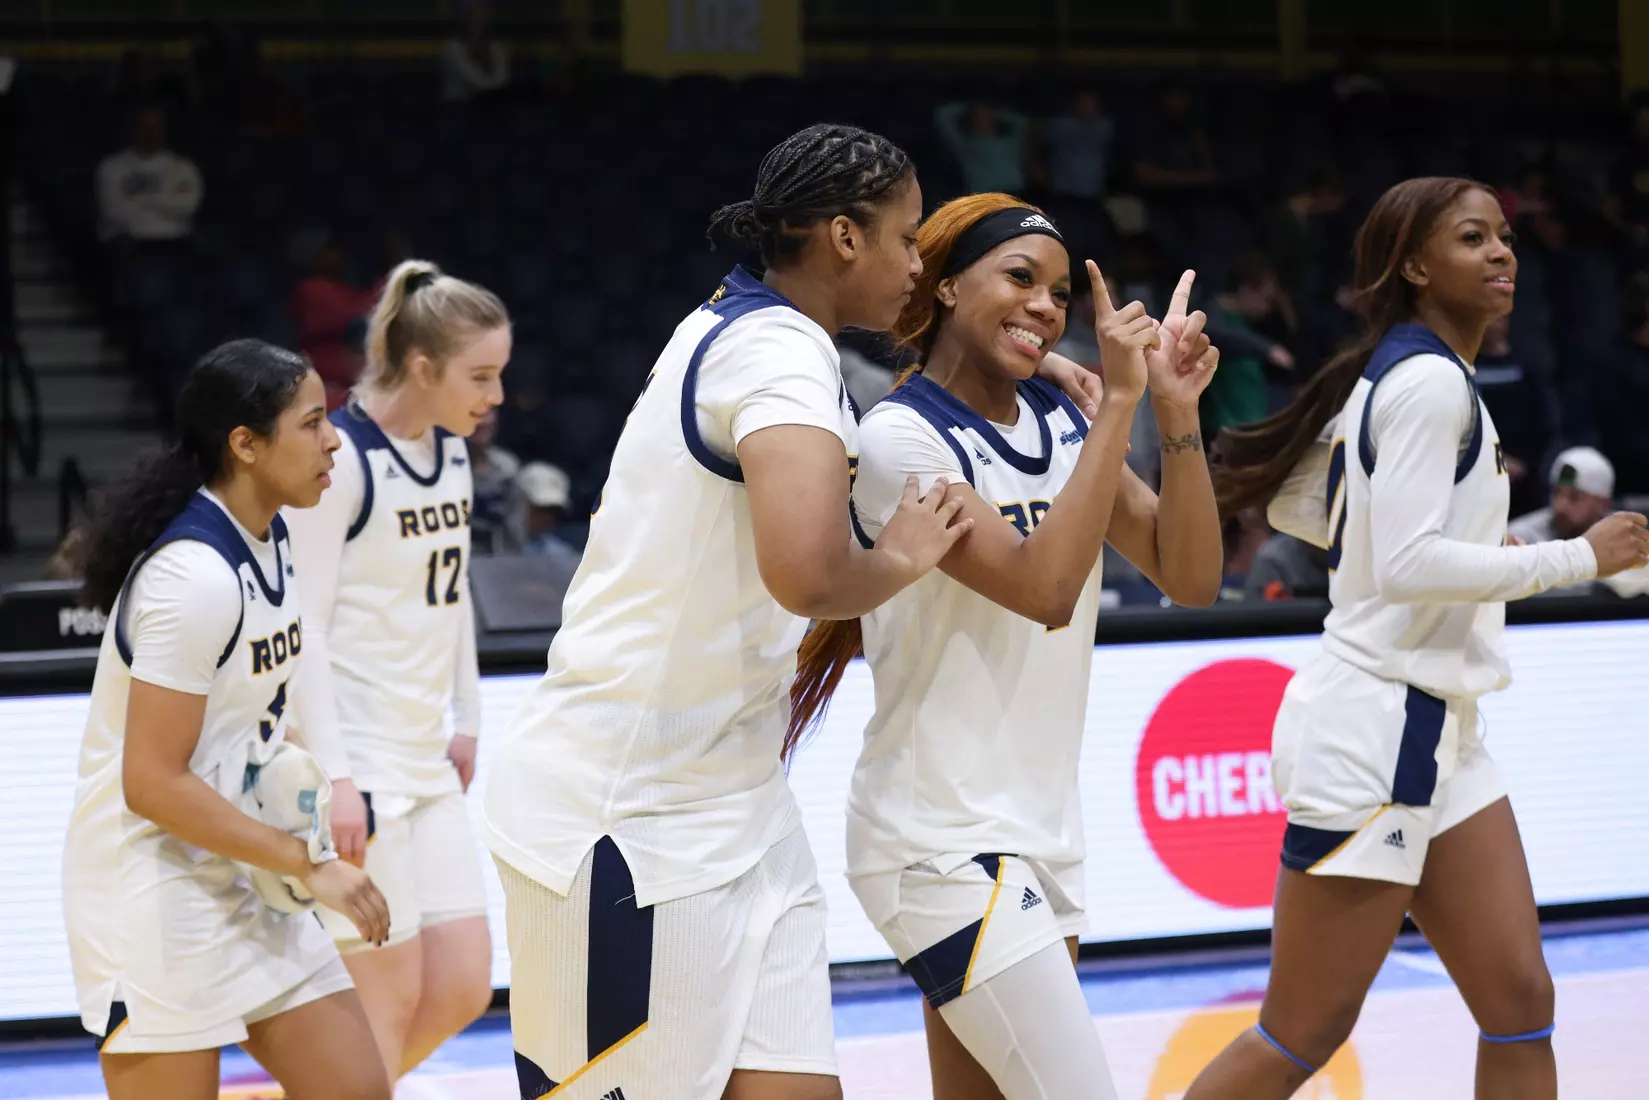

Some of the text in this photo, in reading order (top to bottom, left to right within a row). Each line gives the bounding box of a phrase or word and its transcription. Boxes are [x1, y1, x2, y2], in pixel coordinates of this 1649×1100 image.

[666, 0, 762, 53] 102
[426, 546, 461, 606] 12
[249, 617, 302, 674] ROO
[1153, 752, 1282, 821] CHER
